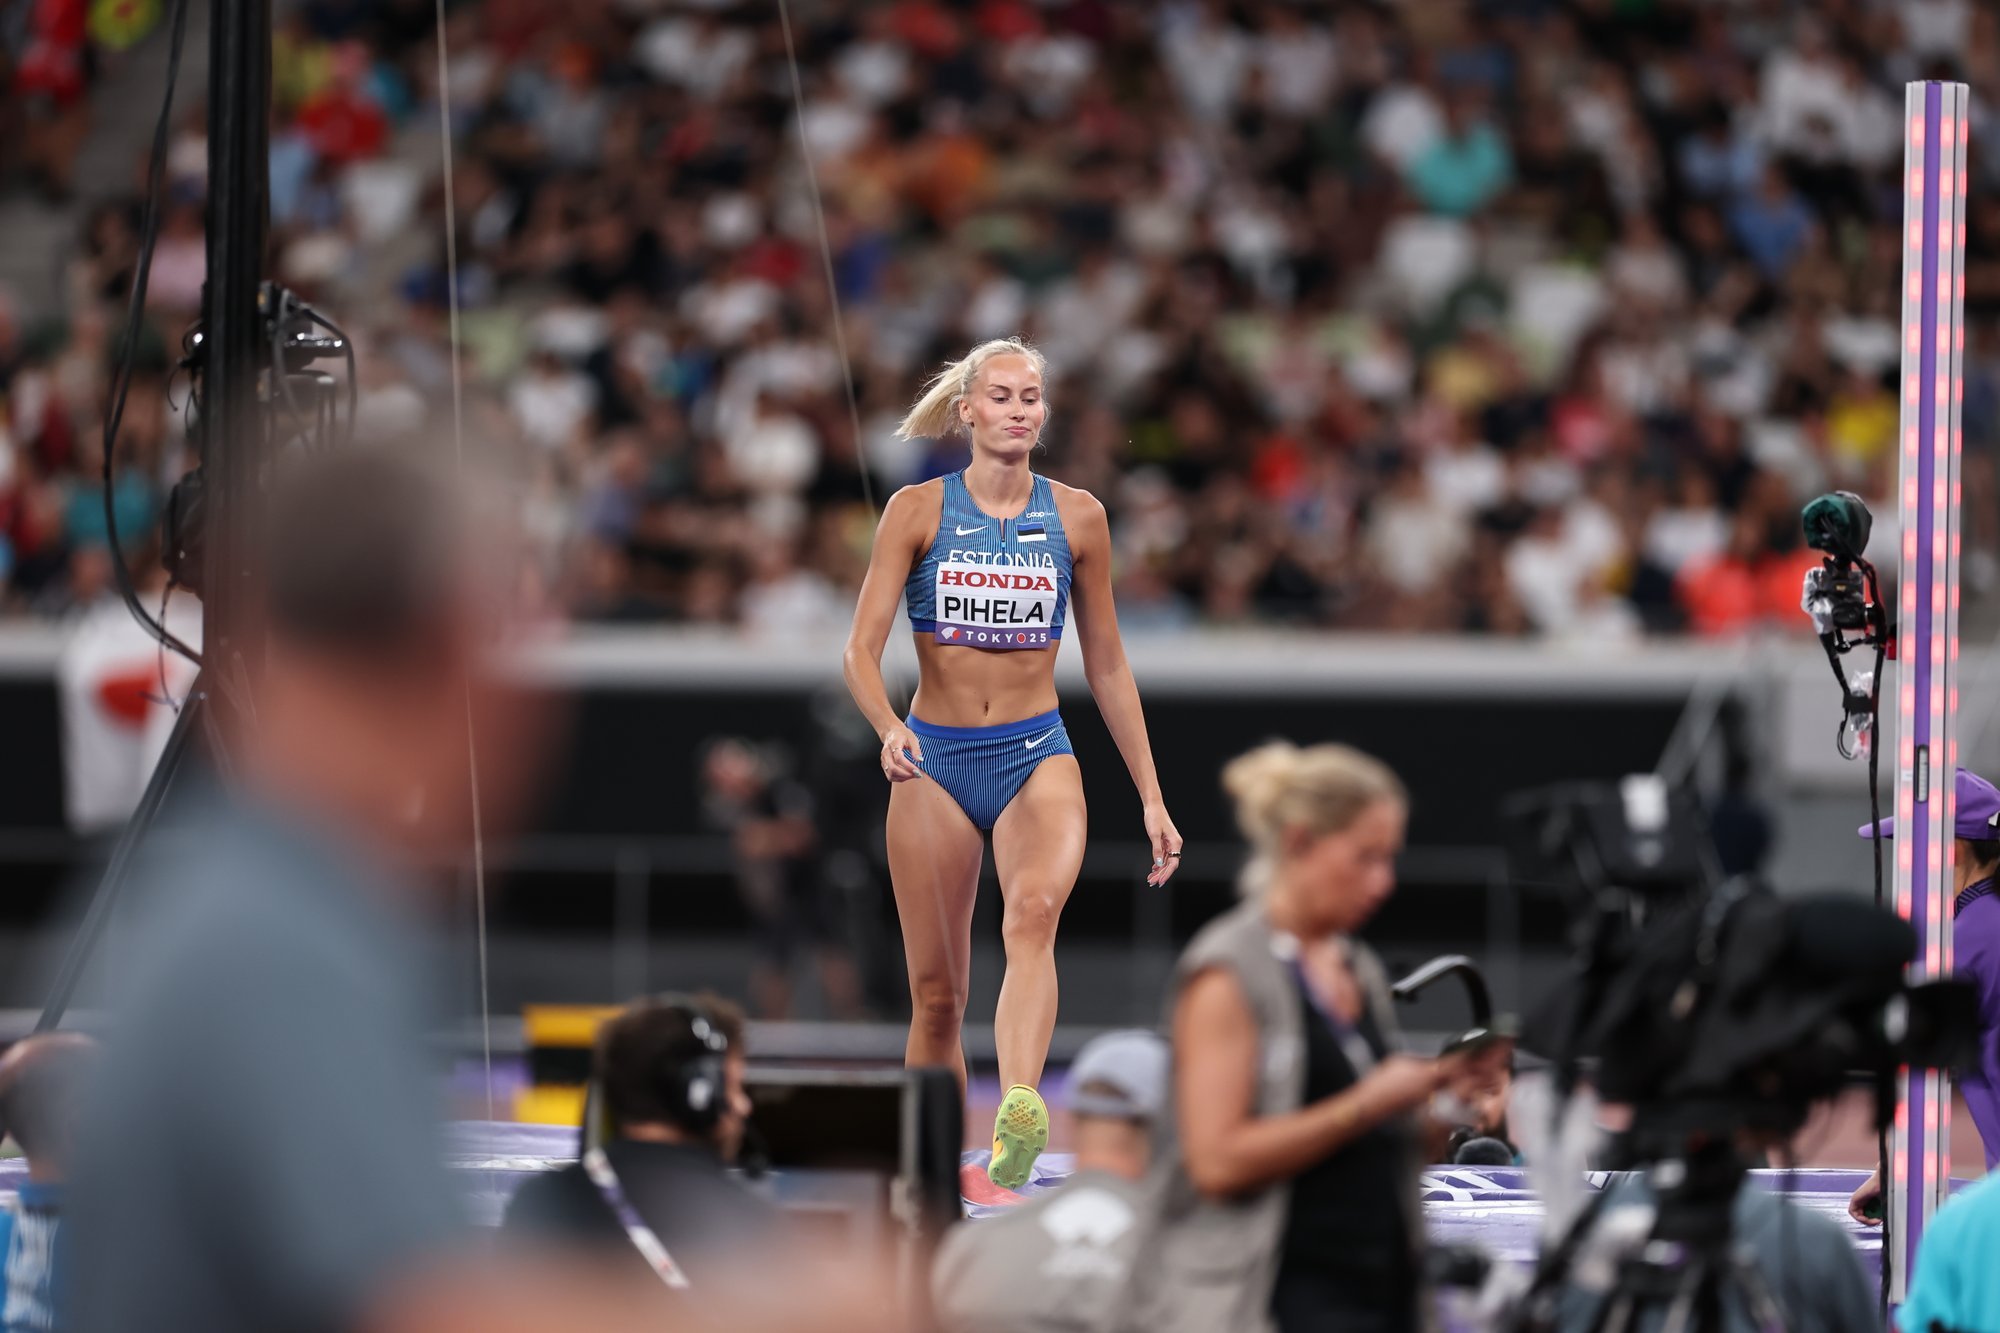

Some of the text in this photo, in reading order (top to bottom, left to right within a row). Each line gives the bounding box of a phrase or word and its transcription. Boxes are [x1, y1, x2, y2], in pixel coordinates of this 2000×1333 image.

[948, 549, 1054, 569] ESTONIA
[939, 570, 1055, 591] HONDA
[944, 596, 1044, 624] PIHELA
